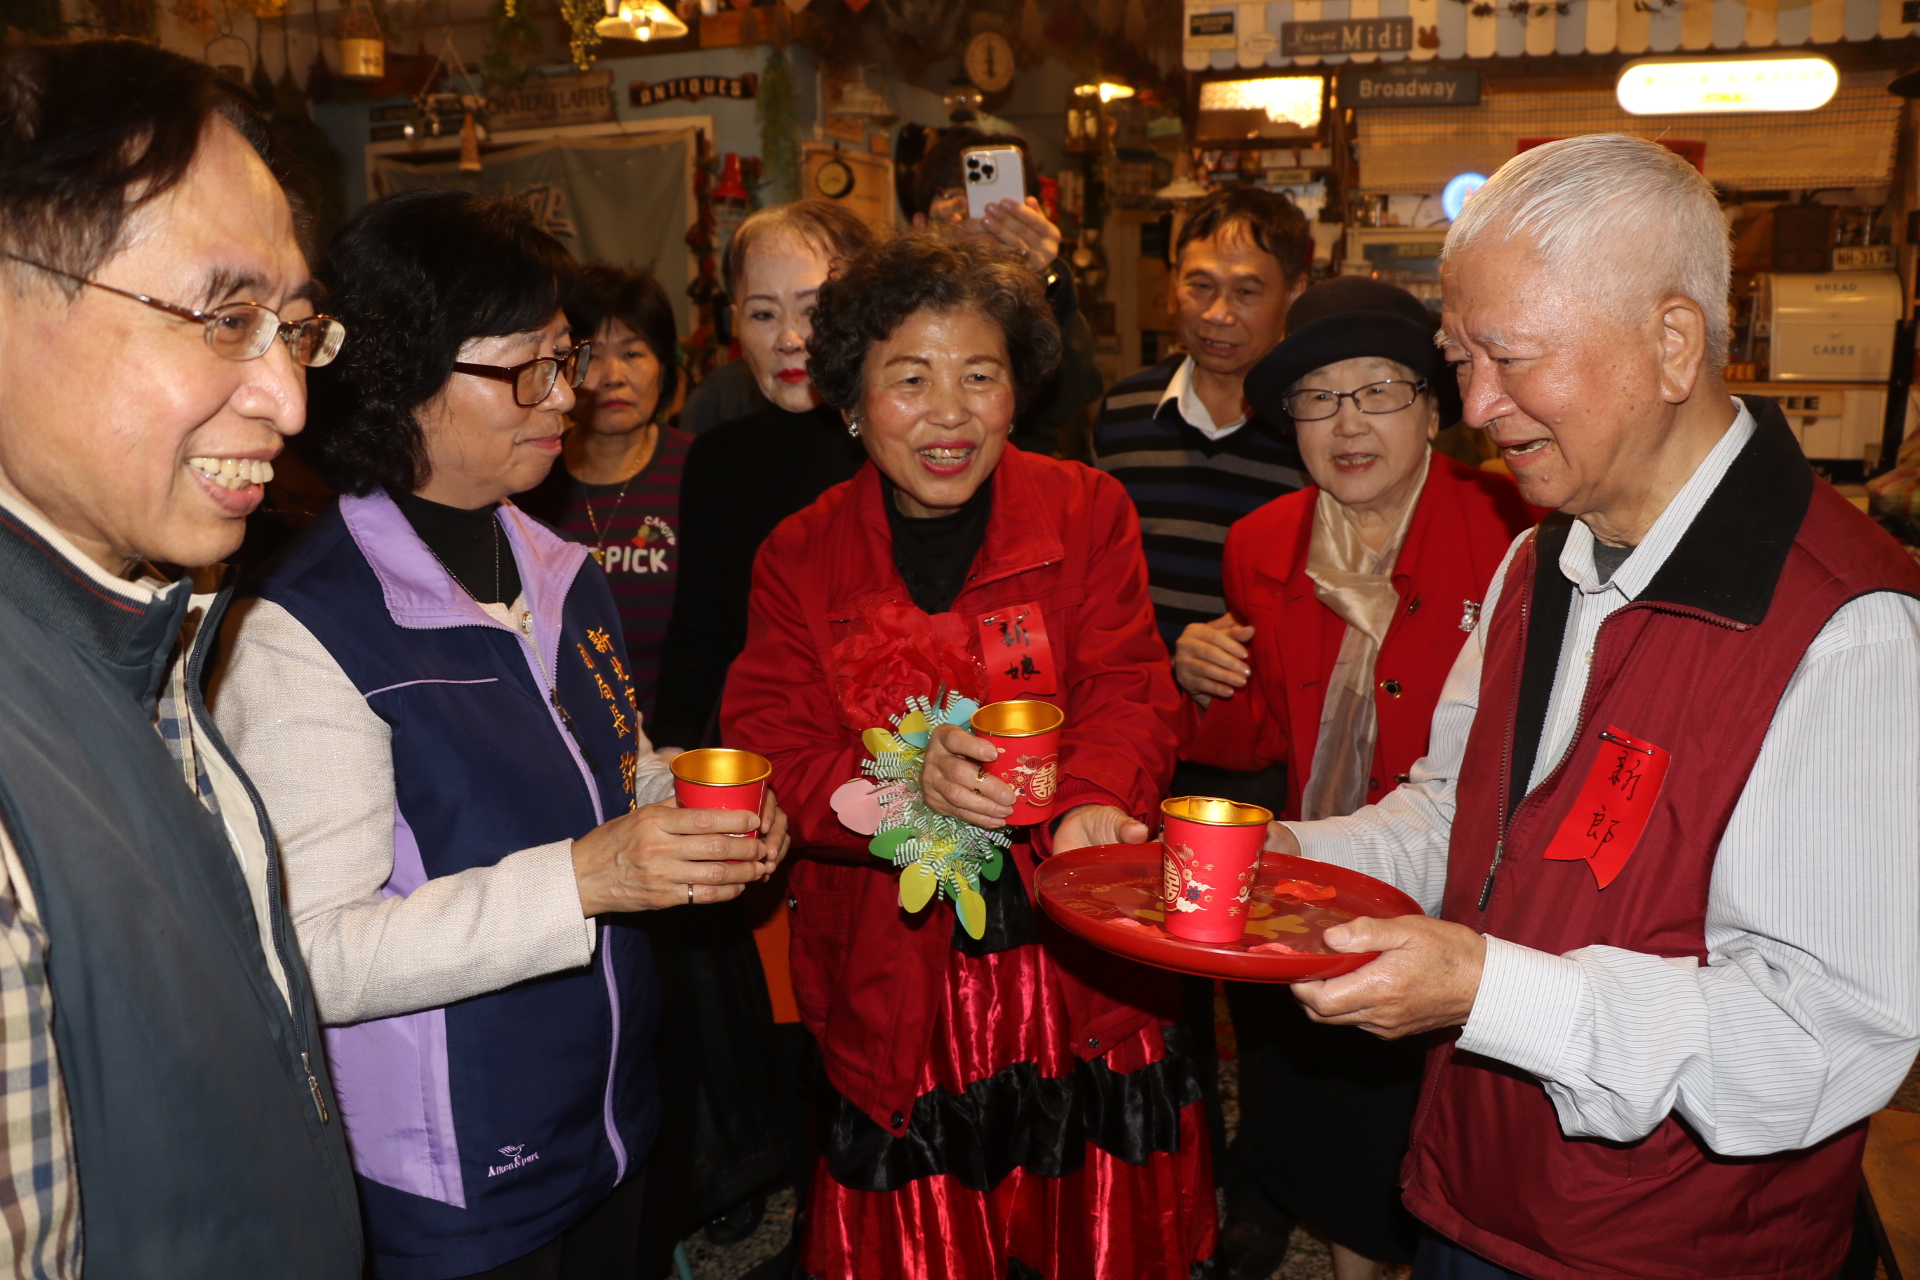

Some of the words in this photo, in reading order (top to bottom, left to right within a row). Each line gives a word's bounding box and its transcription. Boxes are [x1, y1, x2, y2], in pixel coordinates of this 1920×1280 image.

[1341, 22, 1403, 51] Midi
[640, 77, 742, 104] ANTIQUES
[1358, 78, 1458, 101] Broadway
[1814, 283, 1858, 292] BREAD
[1813, 344, 1856, 356] CAKES
[644, 515, 675, 538] CANDY
[998, 620, 1042, 681] 新娘
[1586, 749, 1643, 859] 新郎
